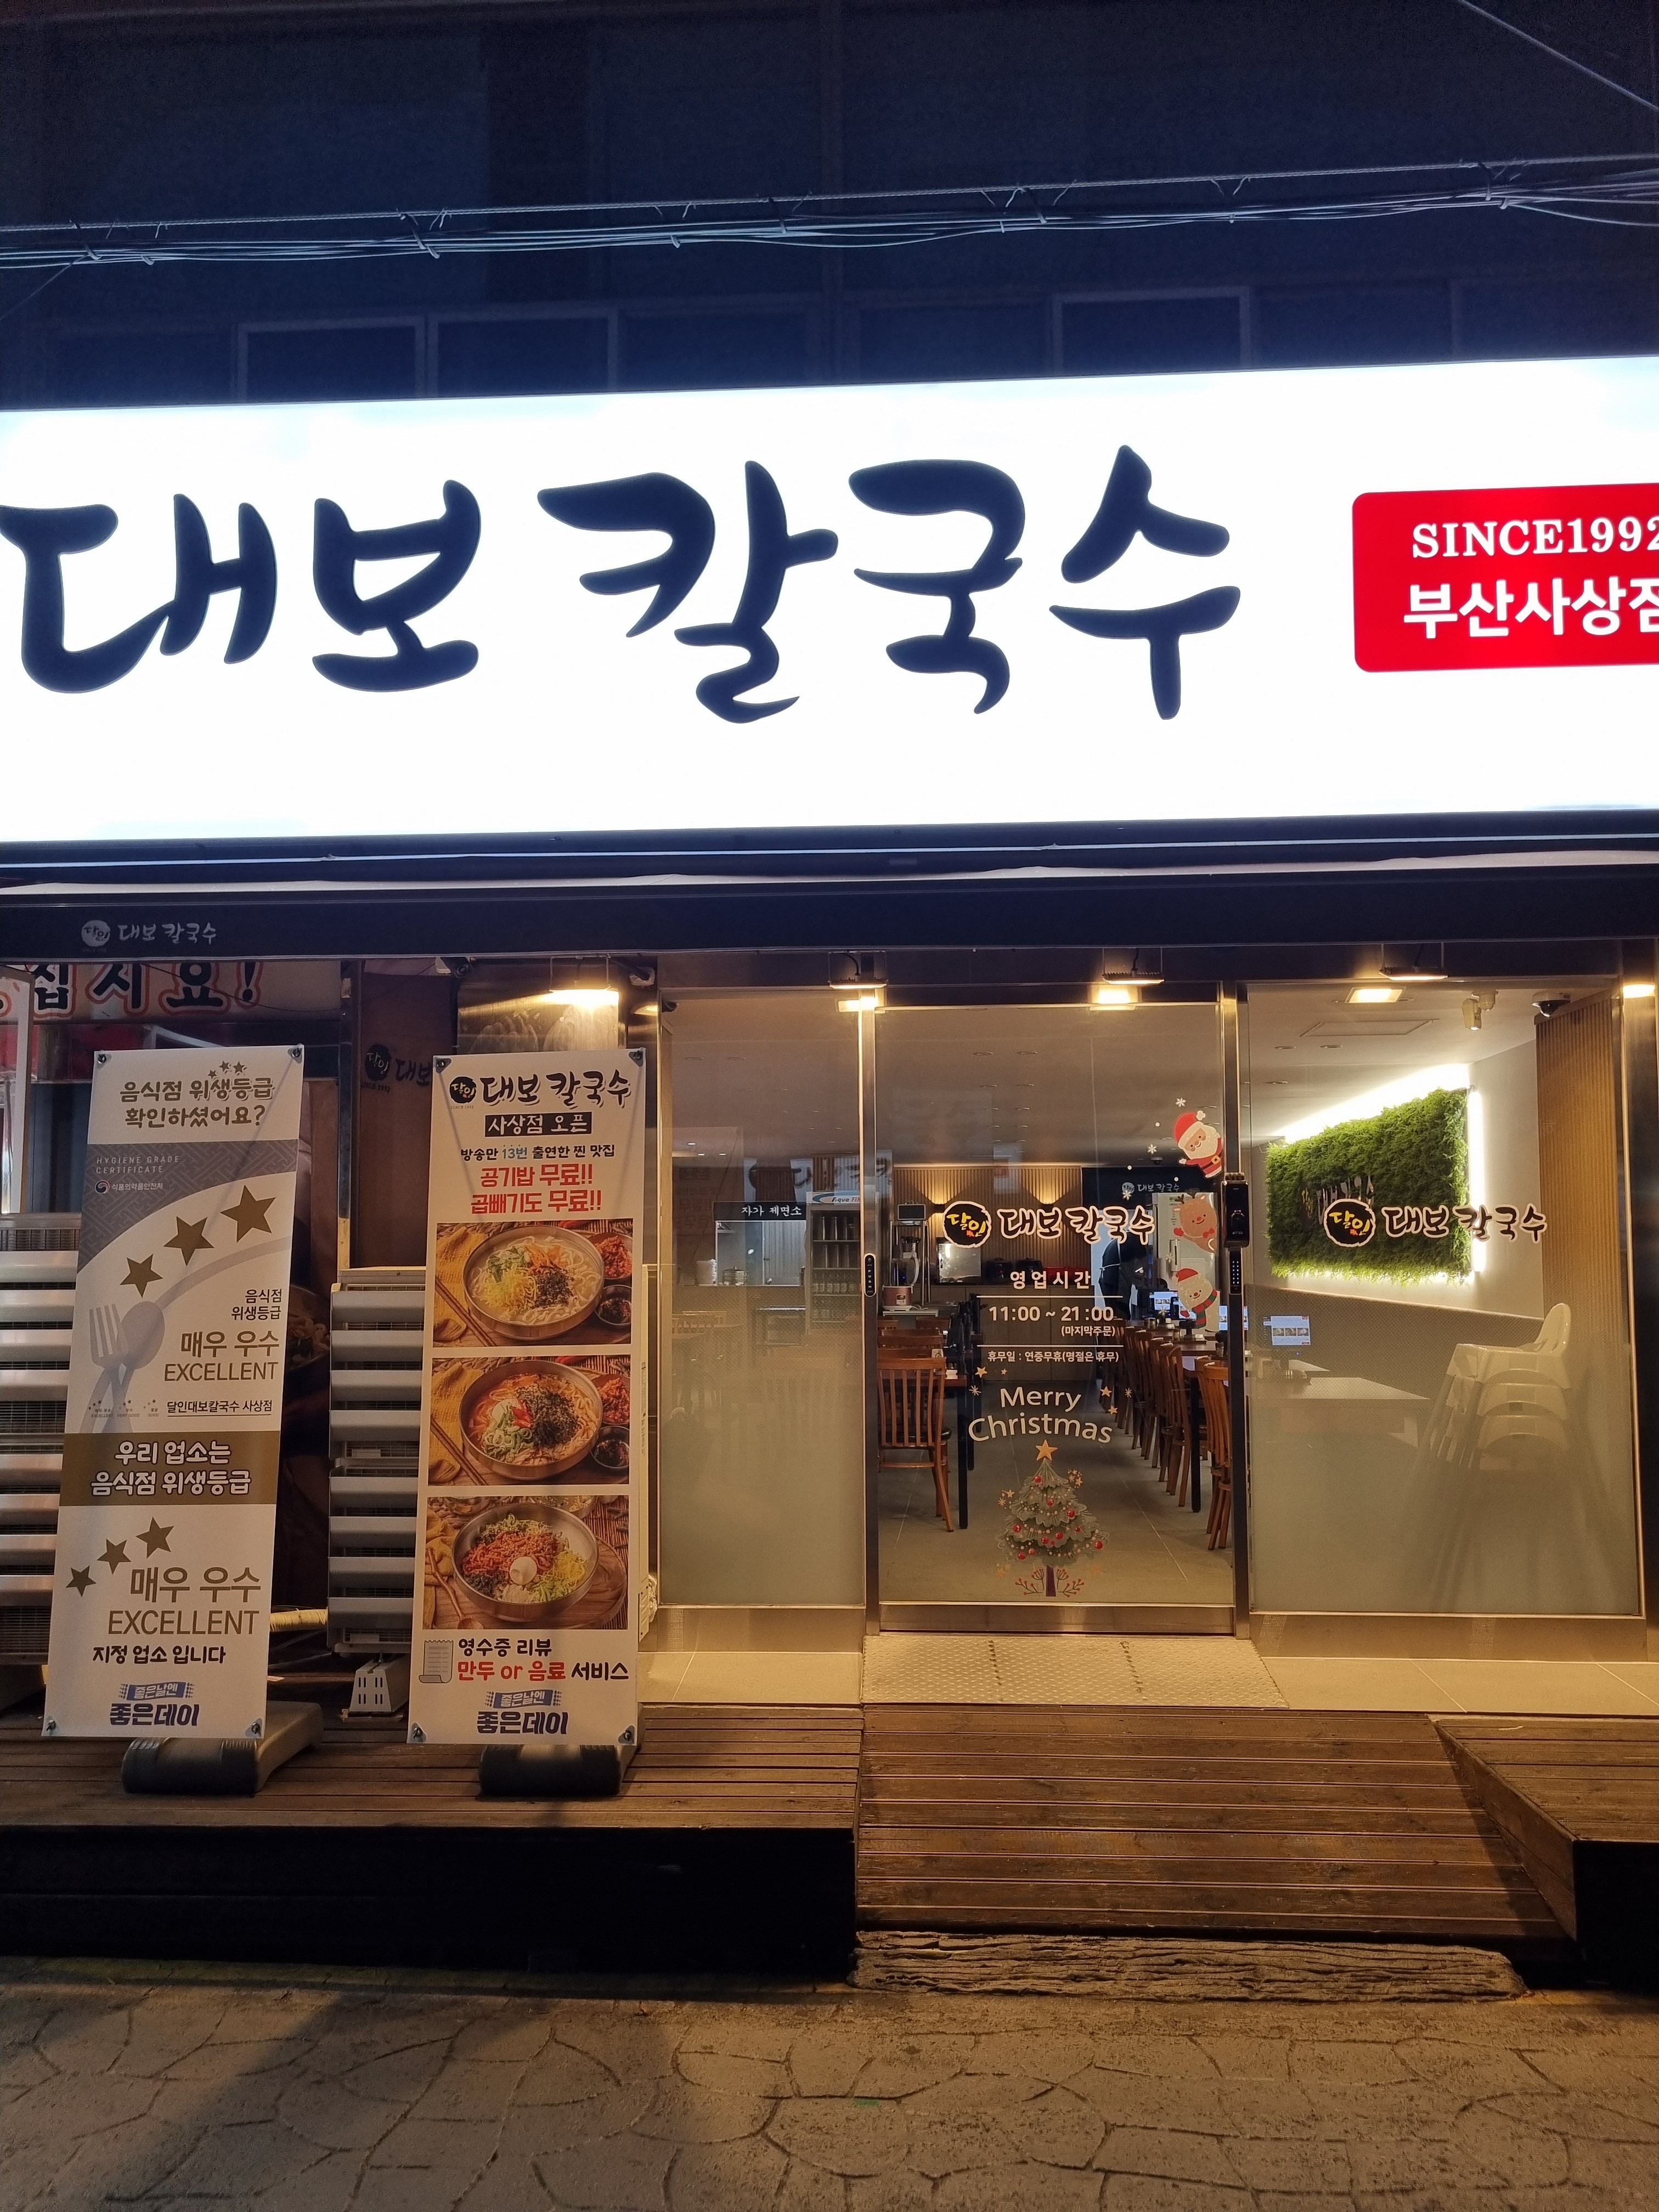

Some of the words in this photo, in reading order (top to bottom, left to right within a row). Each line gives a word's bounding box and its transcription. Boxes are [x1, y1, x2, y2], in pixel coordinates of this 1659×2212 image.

[538, 445, 1241, 724] 칼국수
[161, 922, 217, 945] 칼국수
[0, 962, 259, 1011] 십시요!
[120, 1080, 182, 1103] 음식점
[189, 1077, 275, 1101] 위생등급
[451, 1082, 475, 1098] 달인
[479, 1074, 540, 1105] 대보
[545, 1069, 631, 1108] 칼국수
[125, 1104, 266, 1128] 확인하셨어요?
[488, 1114, 544, 1135] 사상점
[550, 1114, 588, 1132] 오픈
[97, 1156, 141, 1165] HYGIENE
[460, 1148, 499, 1161] 방송만
[501, 1146, 528, 1160] 13번
[532, 1146, 571, 1159] 출연한
[590, 1144, 615, 1158] 맛집
[95, 1166, 163, 1174] CERTIFICATE
[480, 1166, 535, 1188] 공기밥
[539, 1163, 593, 1186] 무료!!
[111, 1182, 163, 1190] 식품의약품안전처
[471, 1192, 543, 1214] 곱빼기도
[548, 1189, 602, 1212] 무료!!
[741, 1205, 765, 1217] 자가
[769, 1205, 802, 1217] 제면소
[946, 1212, 986, 1238] 달인
[996, 1206, 1063, 1240] 대보
[1065, 1205, 1156, 1245] 칼국수
[1328, 1210, 1370, 1236] 달인
[1381, 1205, 1449, 1238] 대보
[1452, 1203, 1548, 1244] 칼국수
[245, 1289, 283, 1305] 음식점
[231, 1305, 282, 1321] 위생등급
[989, 1306, 1041, 1321] 11:00
[1061, 1325, 1115, 1337] (마지막주문)
[181, 1331, 227, 1358] 매우
[234, 1330, 280, 1357] 우수
[988, 1351, 1015, 1362] 휴무일
[1025, 1351, 1094, 1362] 연중무휴(명절은
[1097, 1351, 1119, 1362] 휴무)
[164, 1362, 279, 1382] EXCELLENT
[167, 1401, 240, 1414] 달인대보칼국수
[242, 1400, 273, 1413] 사상점
[1000, 1386, 1082, 1413] Merry
[968, 1412, 1113, 1444] Christmas
[115, 1441, 159, 1465] 우리
[163, 1441, 232, 1465] 업소는
[91, 1471, 156, 1496] 음식점
[162, 1470, 251, 1496] 위생등급
[131, 1566, 190, 1603] 매우
[199, 1566, 261, 1603] 우수
[108, 1610, 260, 1635] EXCELLENT
[92, 1645, 128, 1664] 지정
[133, 1645, 168, 1664] 업소
[173, 1645, 227, 1664] 입니다
[458, 1638, 511, 1657] 영수증
[517, 1638, 552, 1657] 리뷰
[458, 1661, 495, 1681] 만두
[500, 1664, 523, 1680] or
[528, 1660, 566, 1681] 음료
[571, 1662, 629, 1681] 서비스
[133, 1683, 179, 1699] 좋은날엔
[500, 1690, 545, 1707] 좋은날엔
[110, 1703, 200, 1726] 좋은데이
[476, 1711, 568, 1735] 좋은데이
